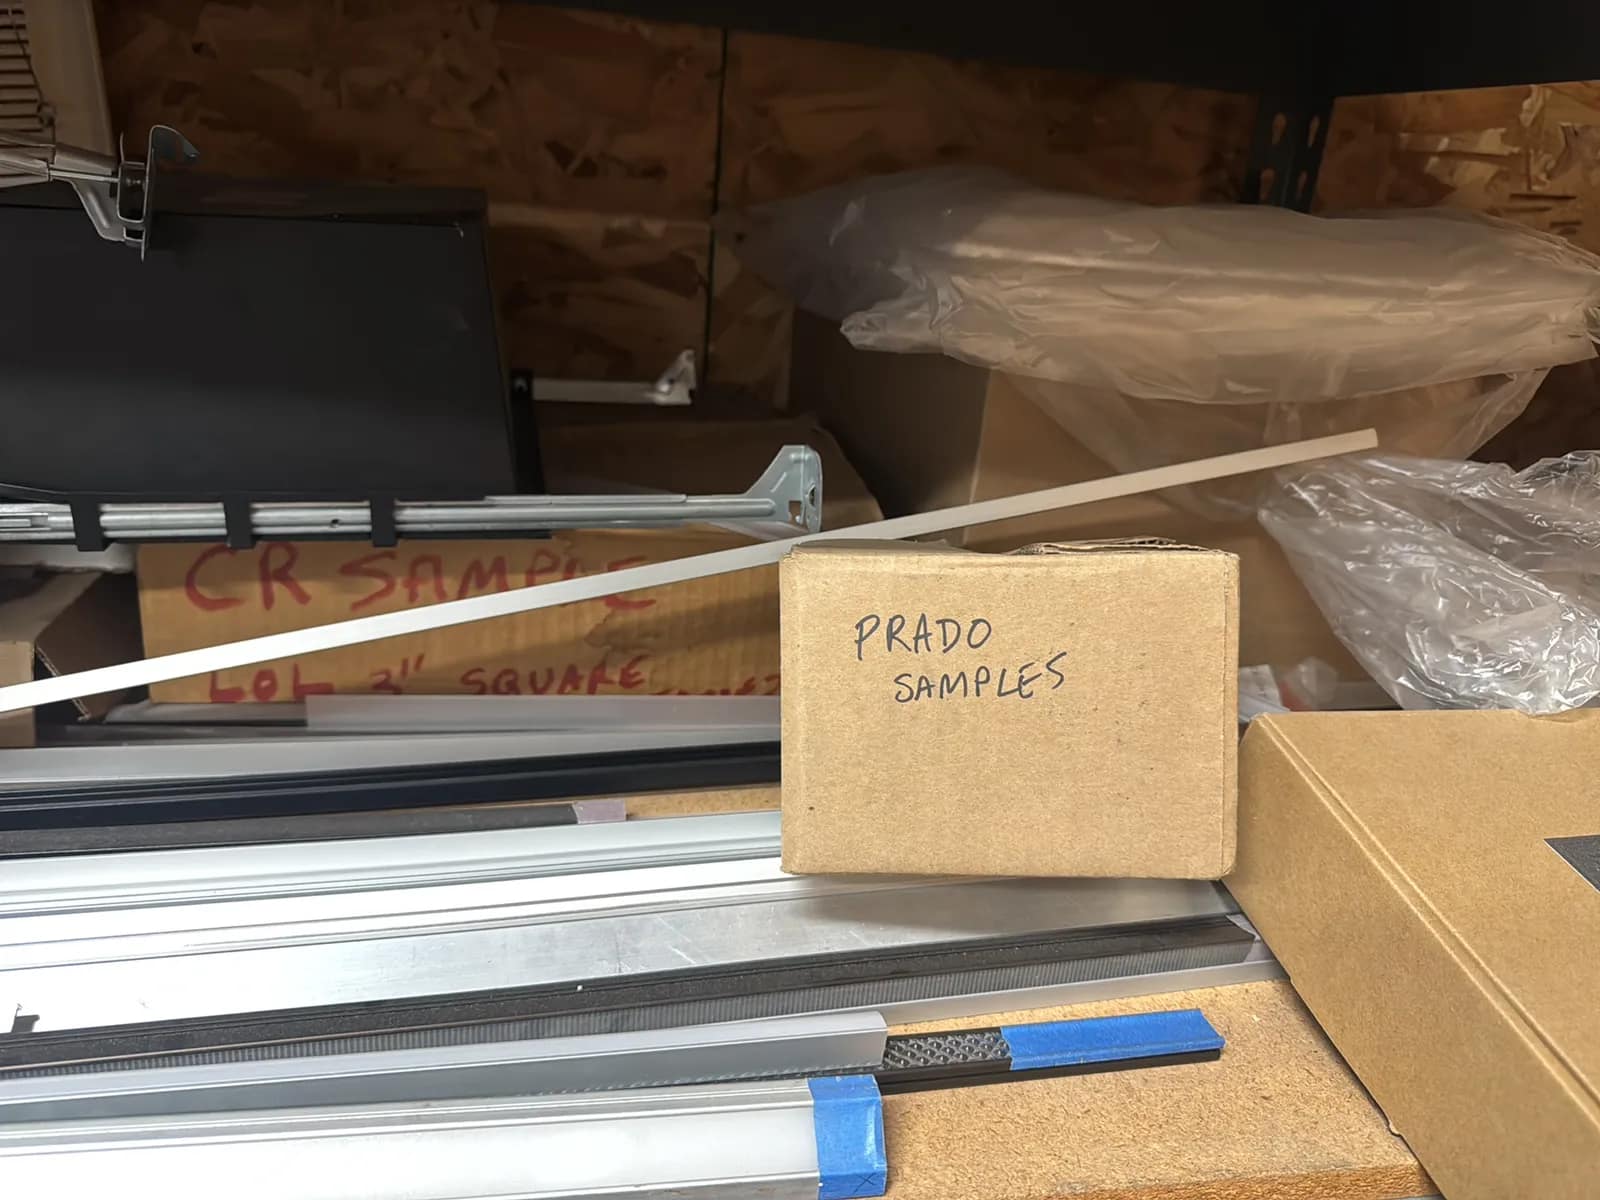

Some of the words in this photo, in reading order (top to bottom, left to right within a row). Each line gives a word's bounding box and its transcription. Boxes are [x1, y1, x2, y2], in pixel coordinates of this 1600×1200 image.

[185, 541, 312, 611] CR
[855, 613, 992, 661] PRADO
[893, 651, 1068, 703] SAMPLES
